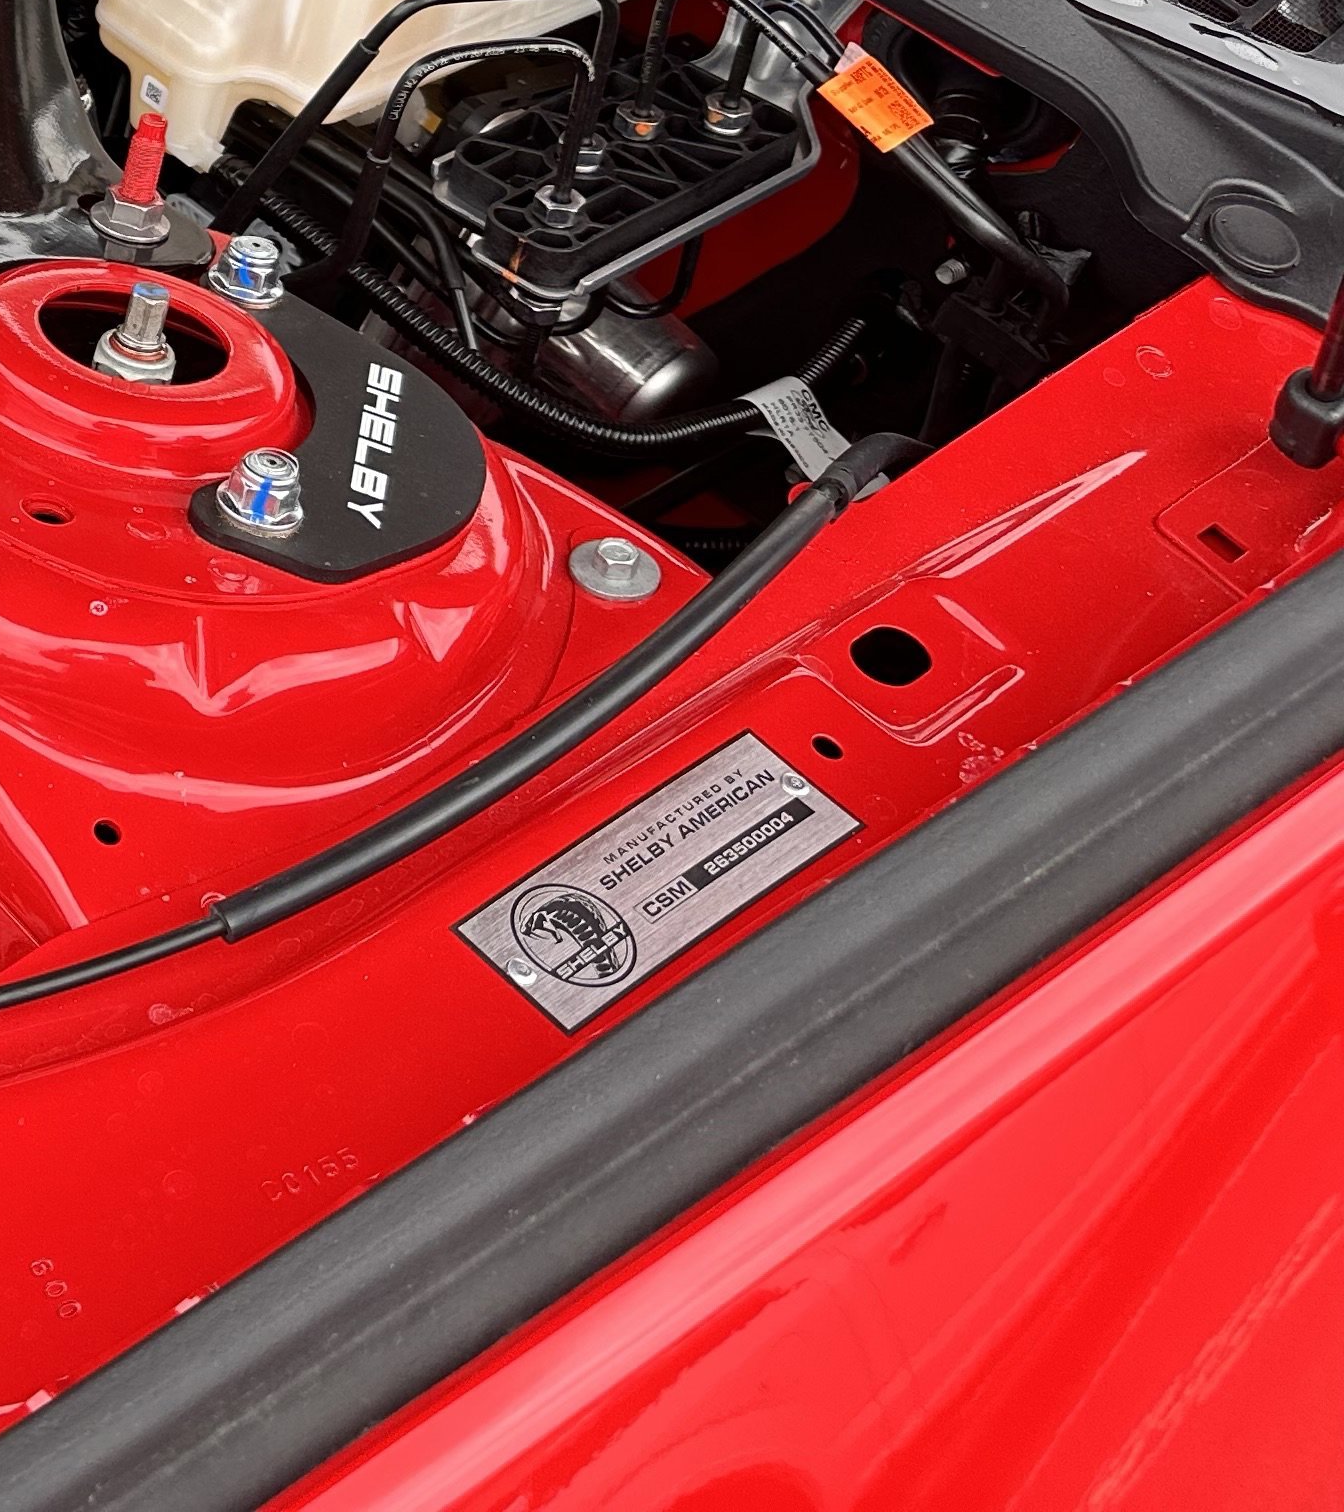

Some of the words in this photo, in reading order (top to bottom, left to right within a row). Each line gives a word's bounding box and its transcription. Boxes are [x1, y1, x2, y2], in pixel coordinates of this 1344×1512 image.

[347, 362, 403, 529] SHELBY
[798, 387, 831, 433] CMC
[599, 833, 675, 891] SHELBY
[677, 768, 776, 840] AMERICAN
[603, 781, 722, 865] MANUFACTURED
[724, 768, 745, 787] BY
[642, 876, 693, 917] CSM
[703, 810, 795, 877] 263500004
[555, 923, 629, 979] SHELBY
